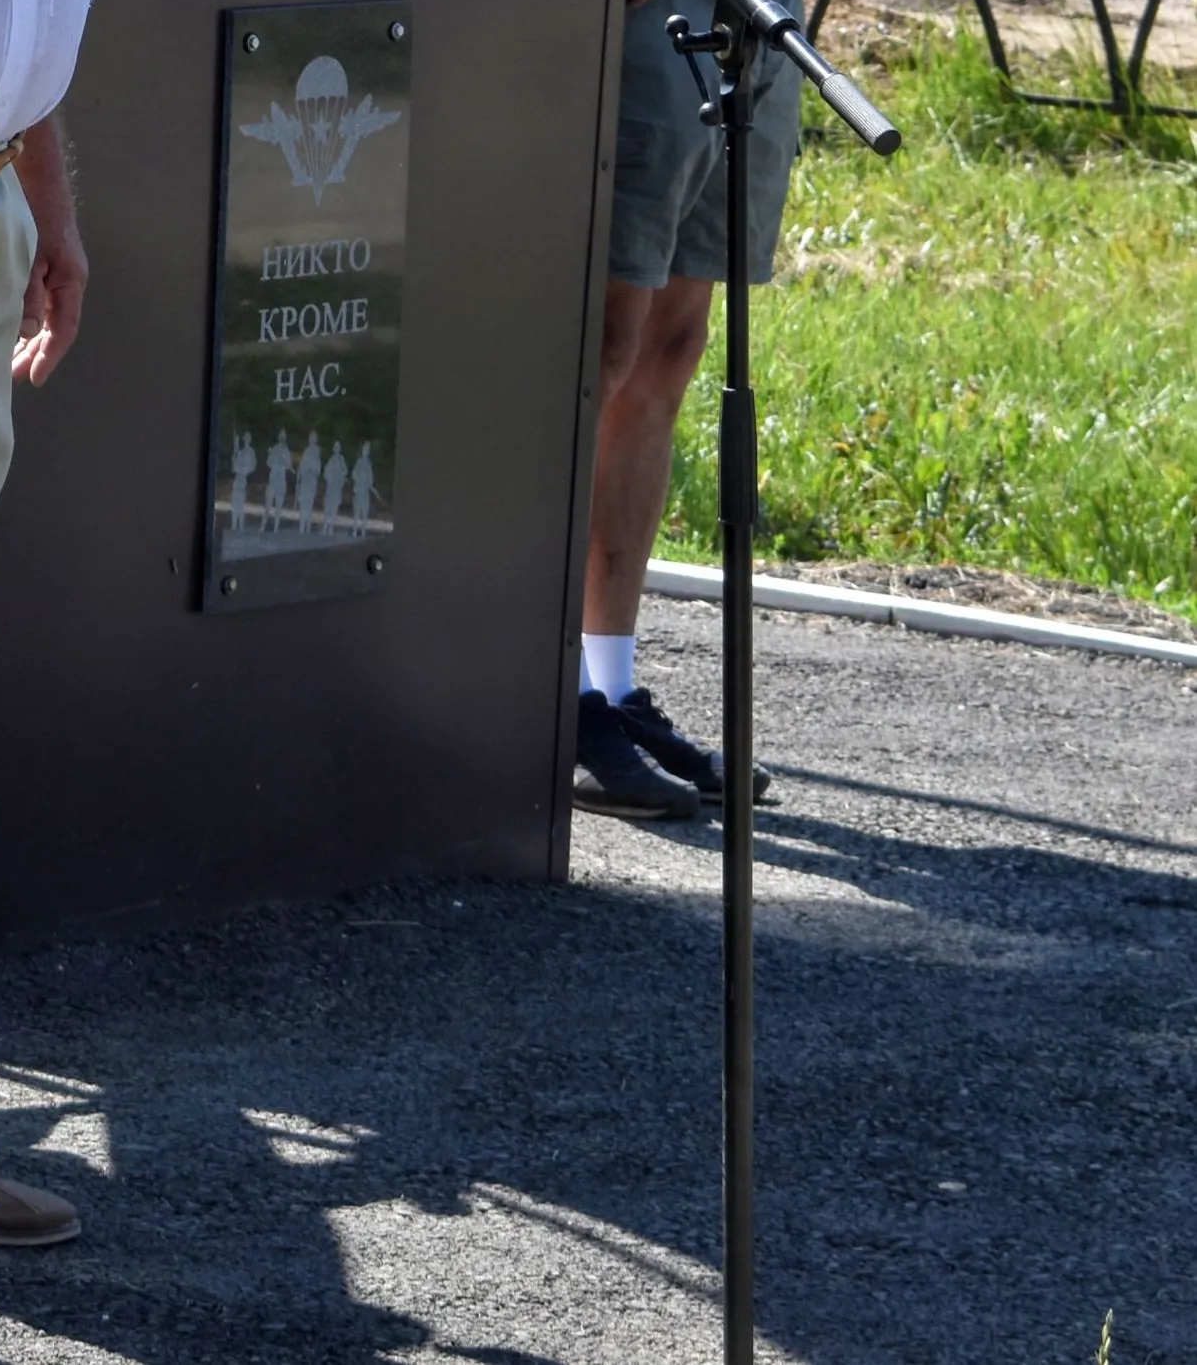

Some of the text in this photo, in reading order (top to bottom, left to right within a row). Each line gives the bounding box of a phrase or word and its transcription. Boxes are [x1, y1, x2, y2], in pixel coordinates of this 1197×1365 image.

[261, 238, 371, 281] НИКТО
[258, 298, 369, 343] КРОМЕ
[273, 363, 347, 403] НАС.
